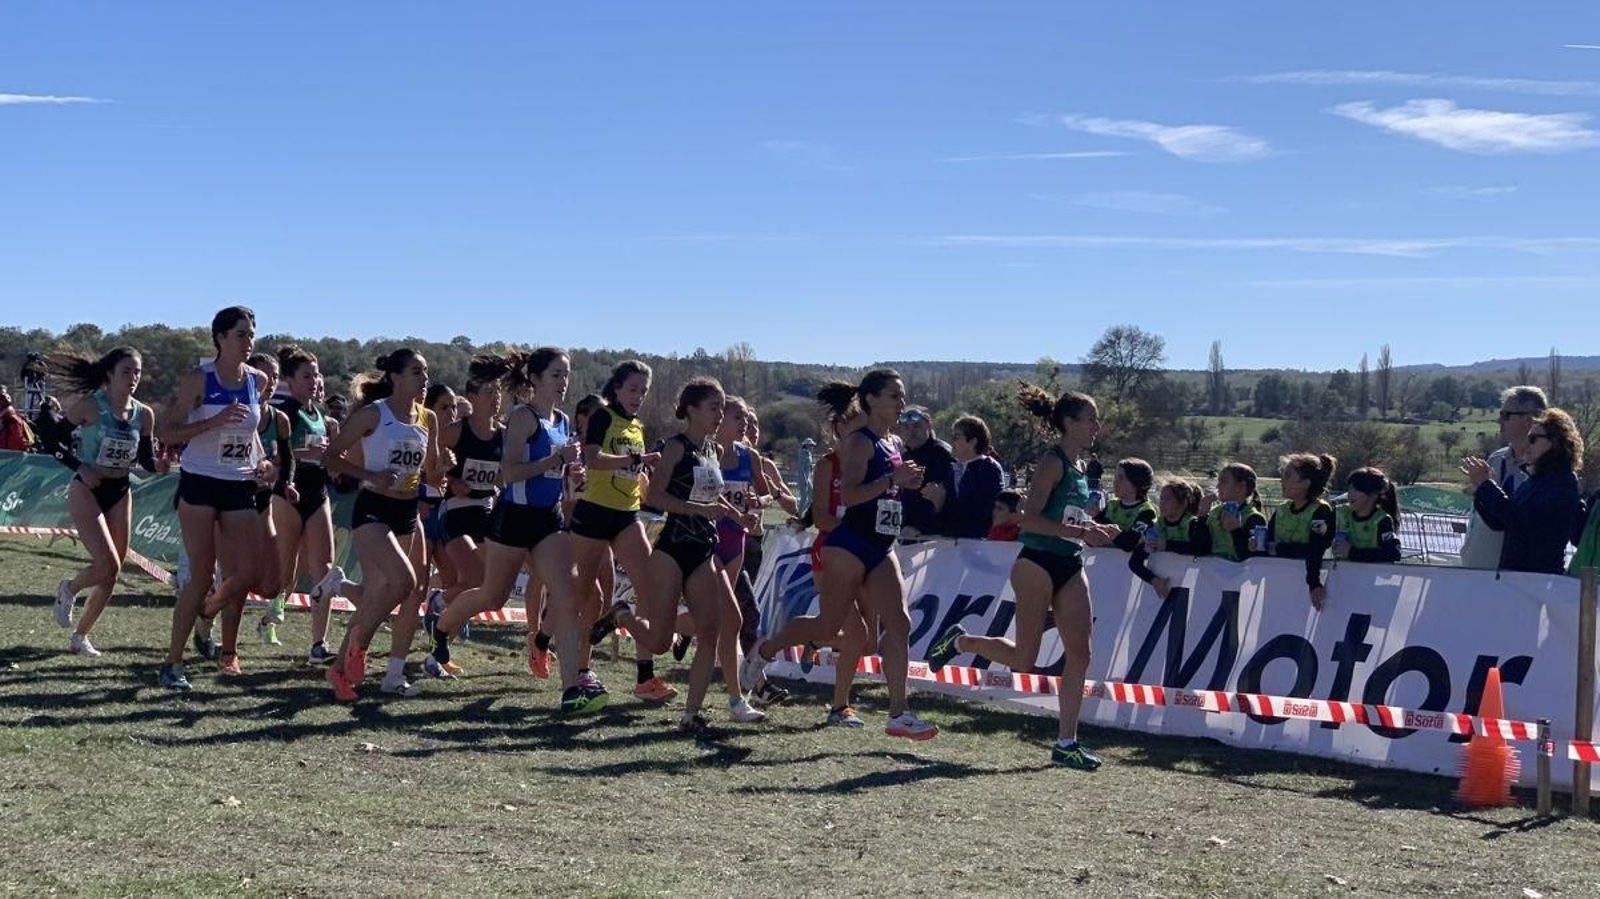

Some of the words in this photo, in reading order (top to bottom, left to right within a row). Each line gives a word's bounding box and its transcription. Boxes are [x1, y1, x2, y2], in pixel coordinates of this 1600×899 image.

[389, 450, 422, 466] 209
[466, 468, 495, 484] 200
[135, 514, 172, 545] Caja
[1122, 587, 1534, 744] Motor
